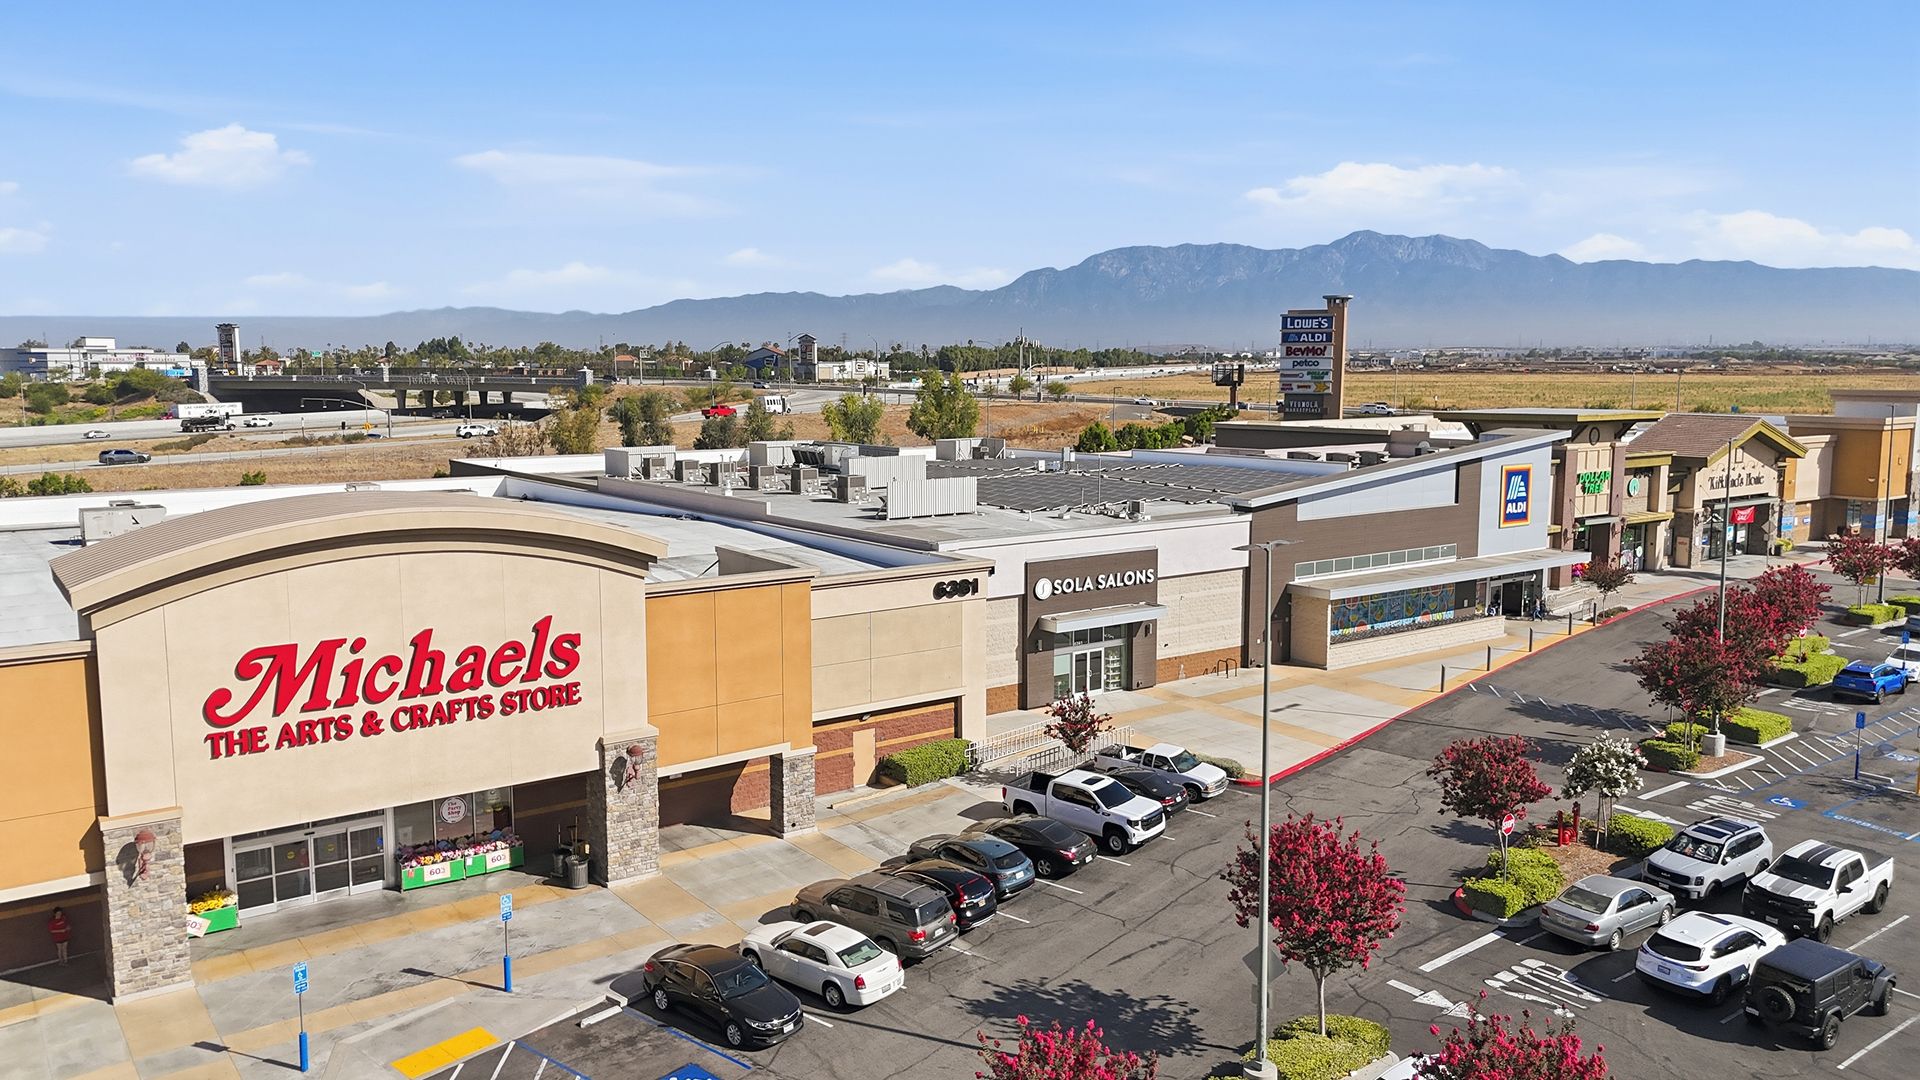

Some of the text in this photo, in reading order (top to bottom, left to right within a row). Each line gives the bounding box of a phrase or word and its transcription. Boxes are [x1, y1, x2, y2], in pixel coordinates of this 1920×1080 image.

[1287, 317, 1328, 329] LOWE'S
[1300, 333, 1326, 342] ALDI
[1285, 345, 1327, 357] BevMo!
[1292, 358, 1320, 368] petco
[1579, 470, 1610, 484] DOLLAR
[1583, 482, 1604, 495] TREE
[1506, 502, 1527, 514] ALDI
[1053, 568, 1155, 595] SOLA SALONS
[203, 615, 582, 728] Michaels
[205, 682, 582, 759] THE ARTS & CRAFTS STORE
